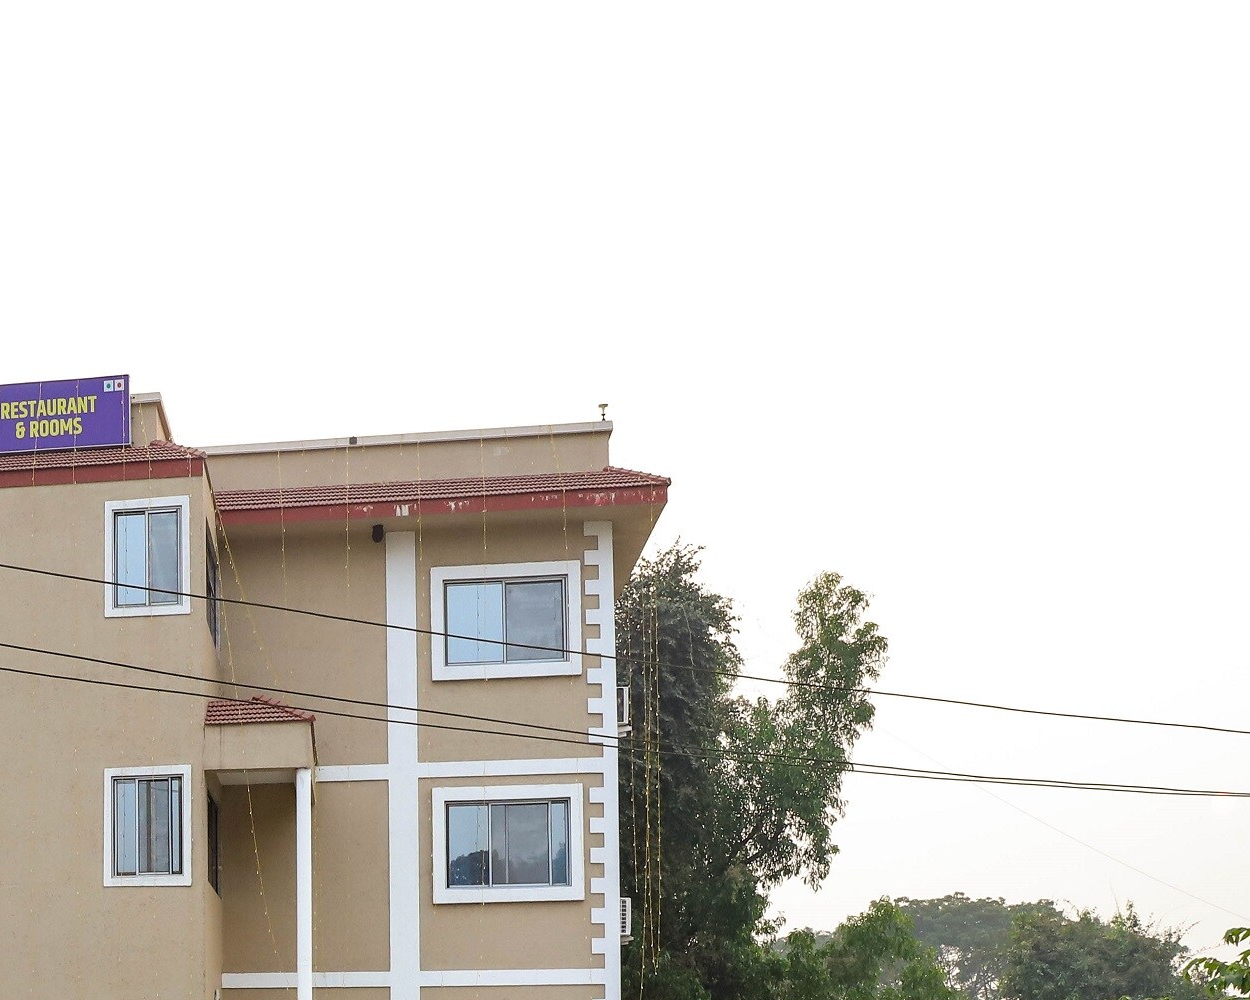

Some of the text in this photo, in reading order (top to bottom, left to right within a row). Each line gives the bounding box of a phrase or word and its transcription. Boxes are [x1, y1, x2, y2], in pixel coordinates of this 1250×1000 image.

[0, 395, 97, 420] RESTAURANT
[15, 417, 83, 439] & ROOMS
